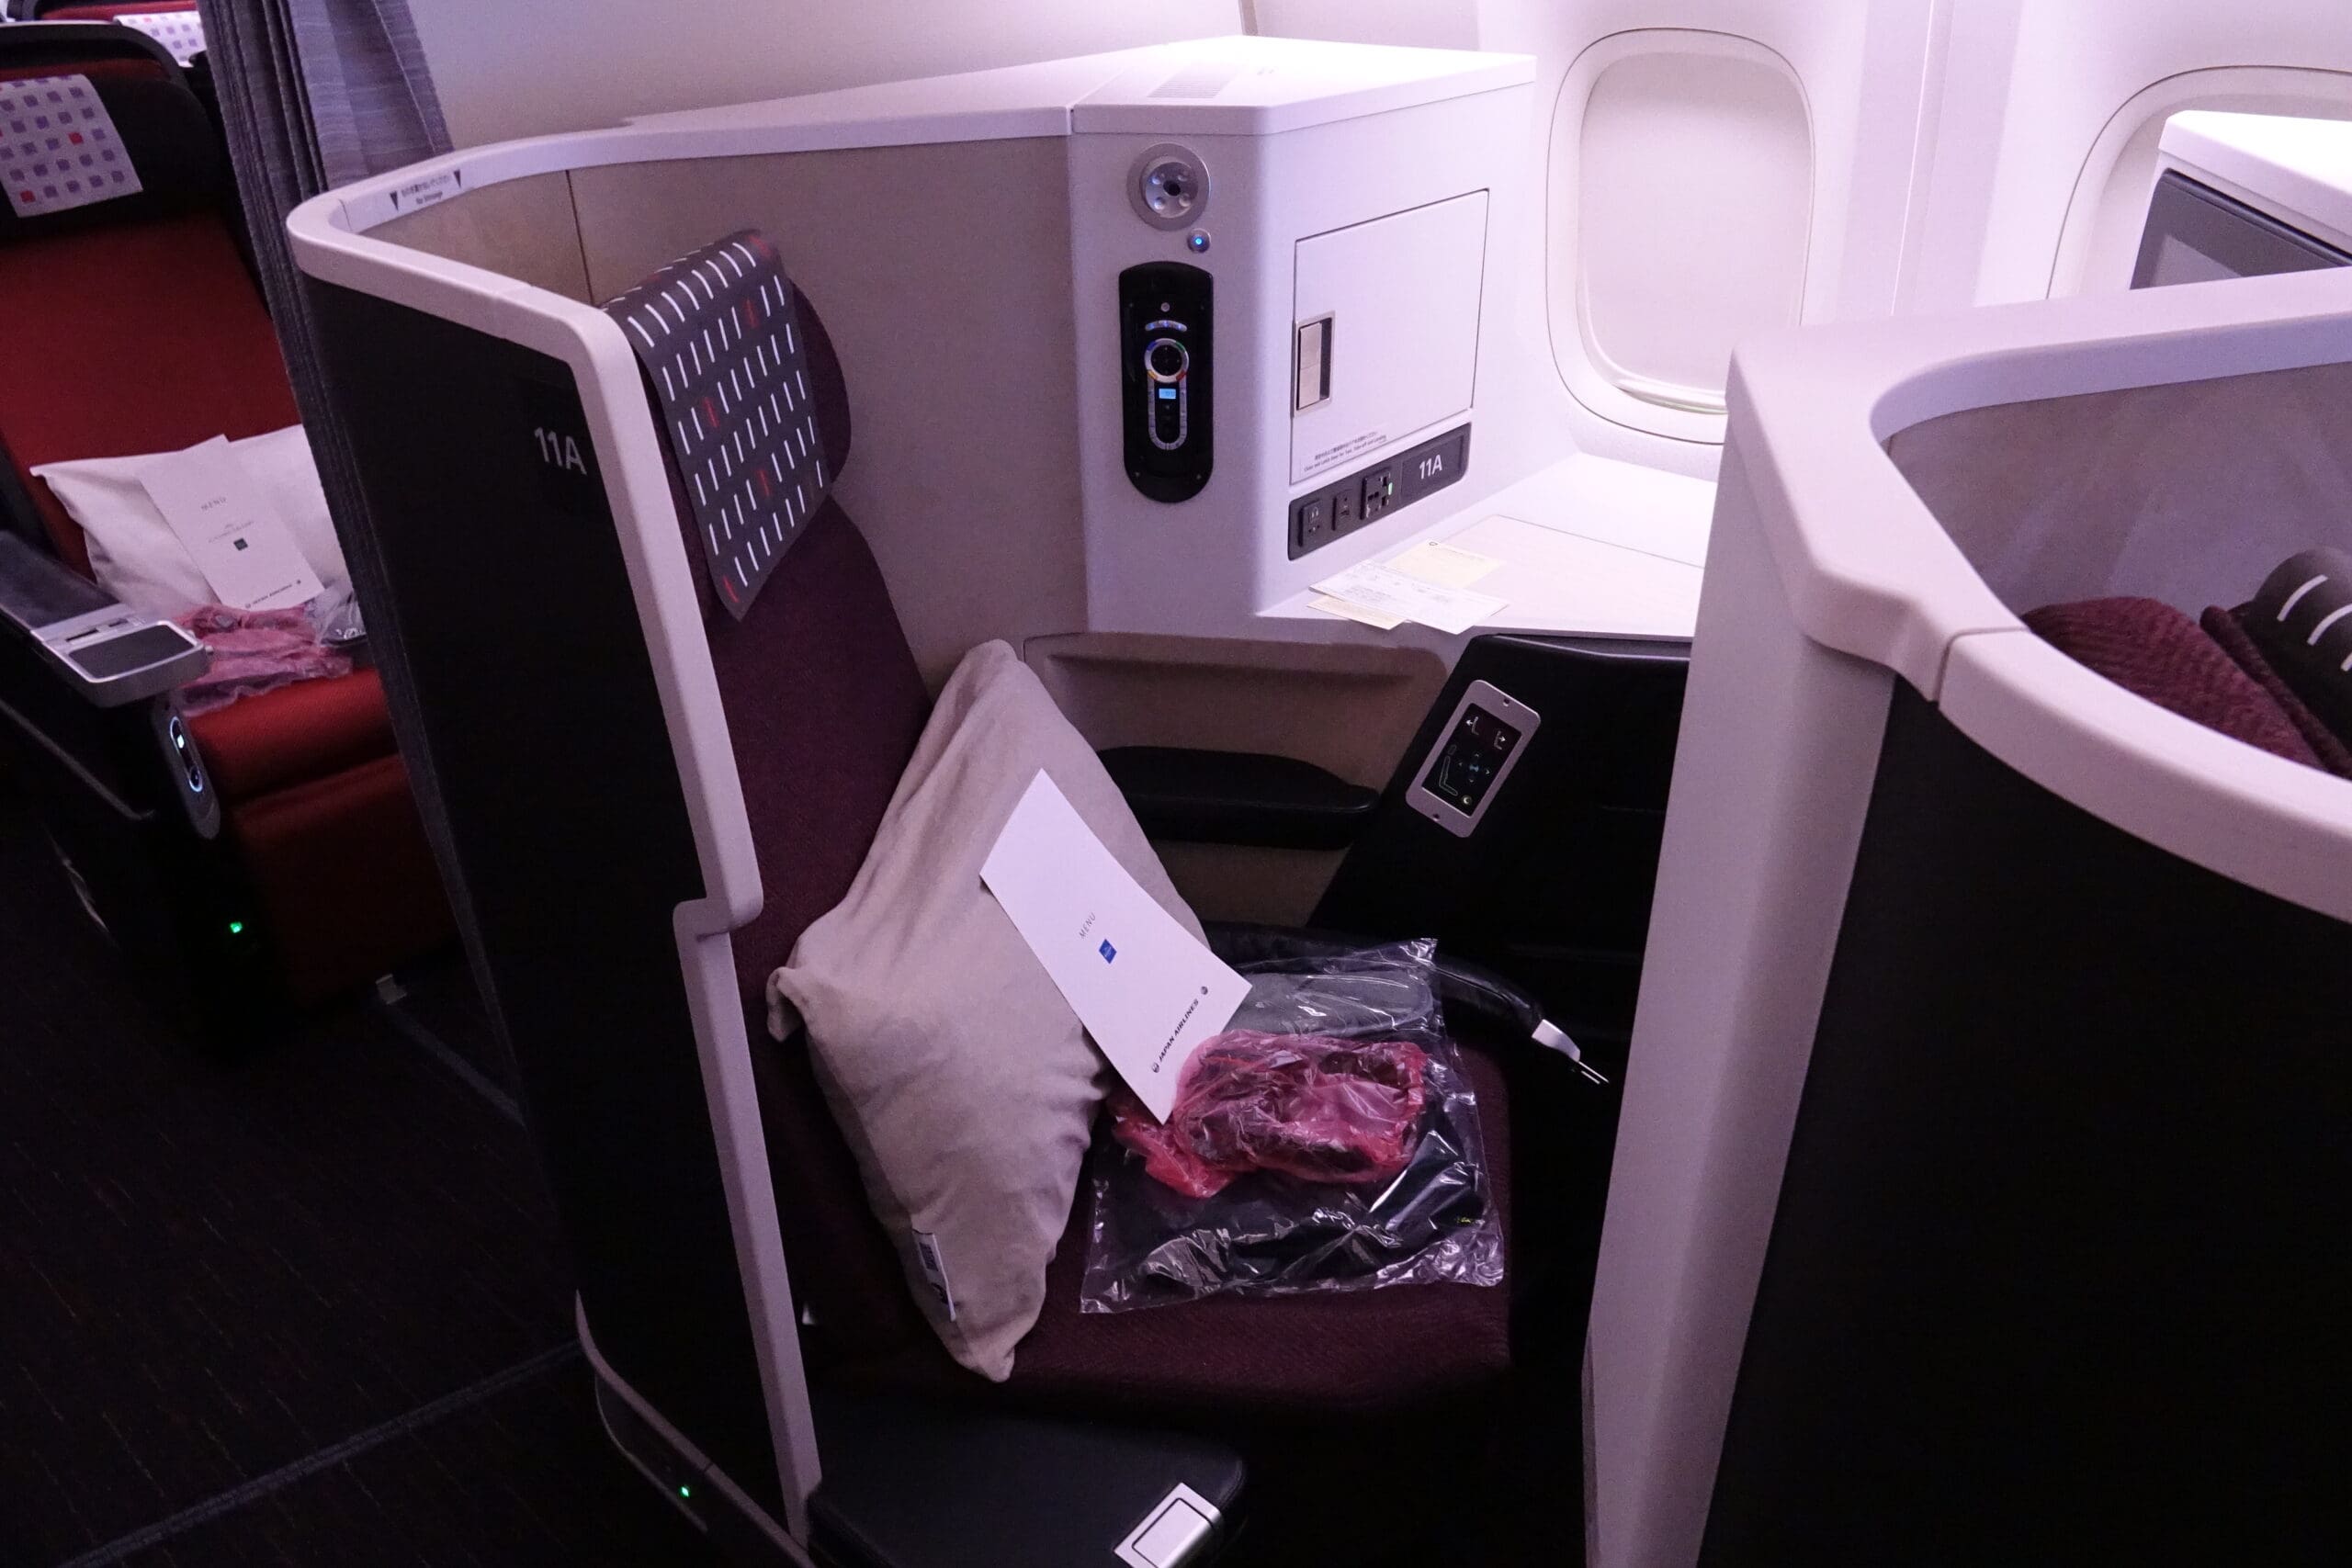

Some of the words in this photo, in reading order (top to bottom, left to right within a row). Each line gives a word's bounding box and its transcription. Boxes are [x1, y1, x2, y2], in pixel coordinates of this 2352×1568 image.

[535, 427, 587, 475] 11A
[1419, 455, 1442, 479] 11A
[1079, 912, 1096, 939] MENU
[1159, 1036, 1175, 1062] JAPAN
[1174, 998, 1199, 1036] AIRLINES
